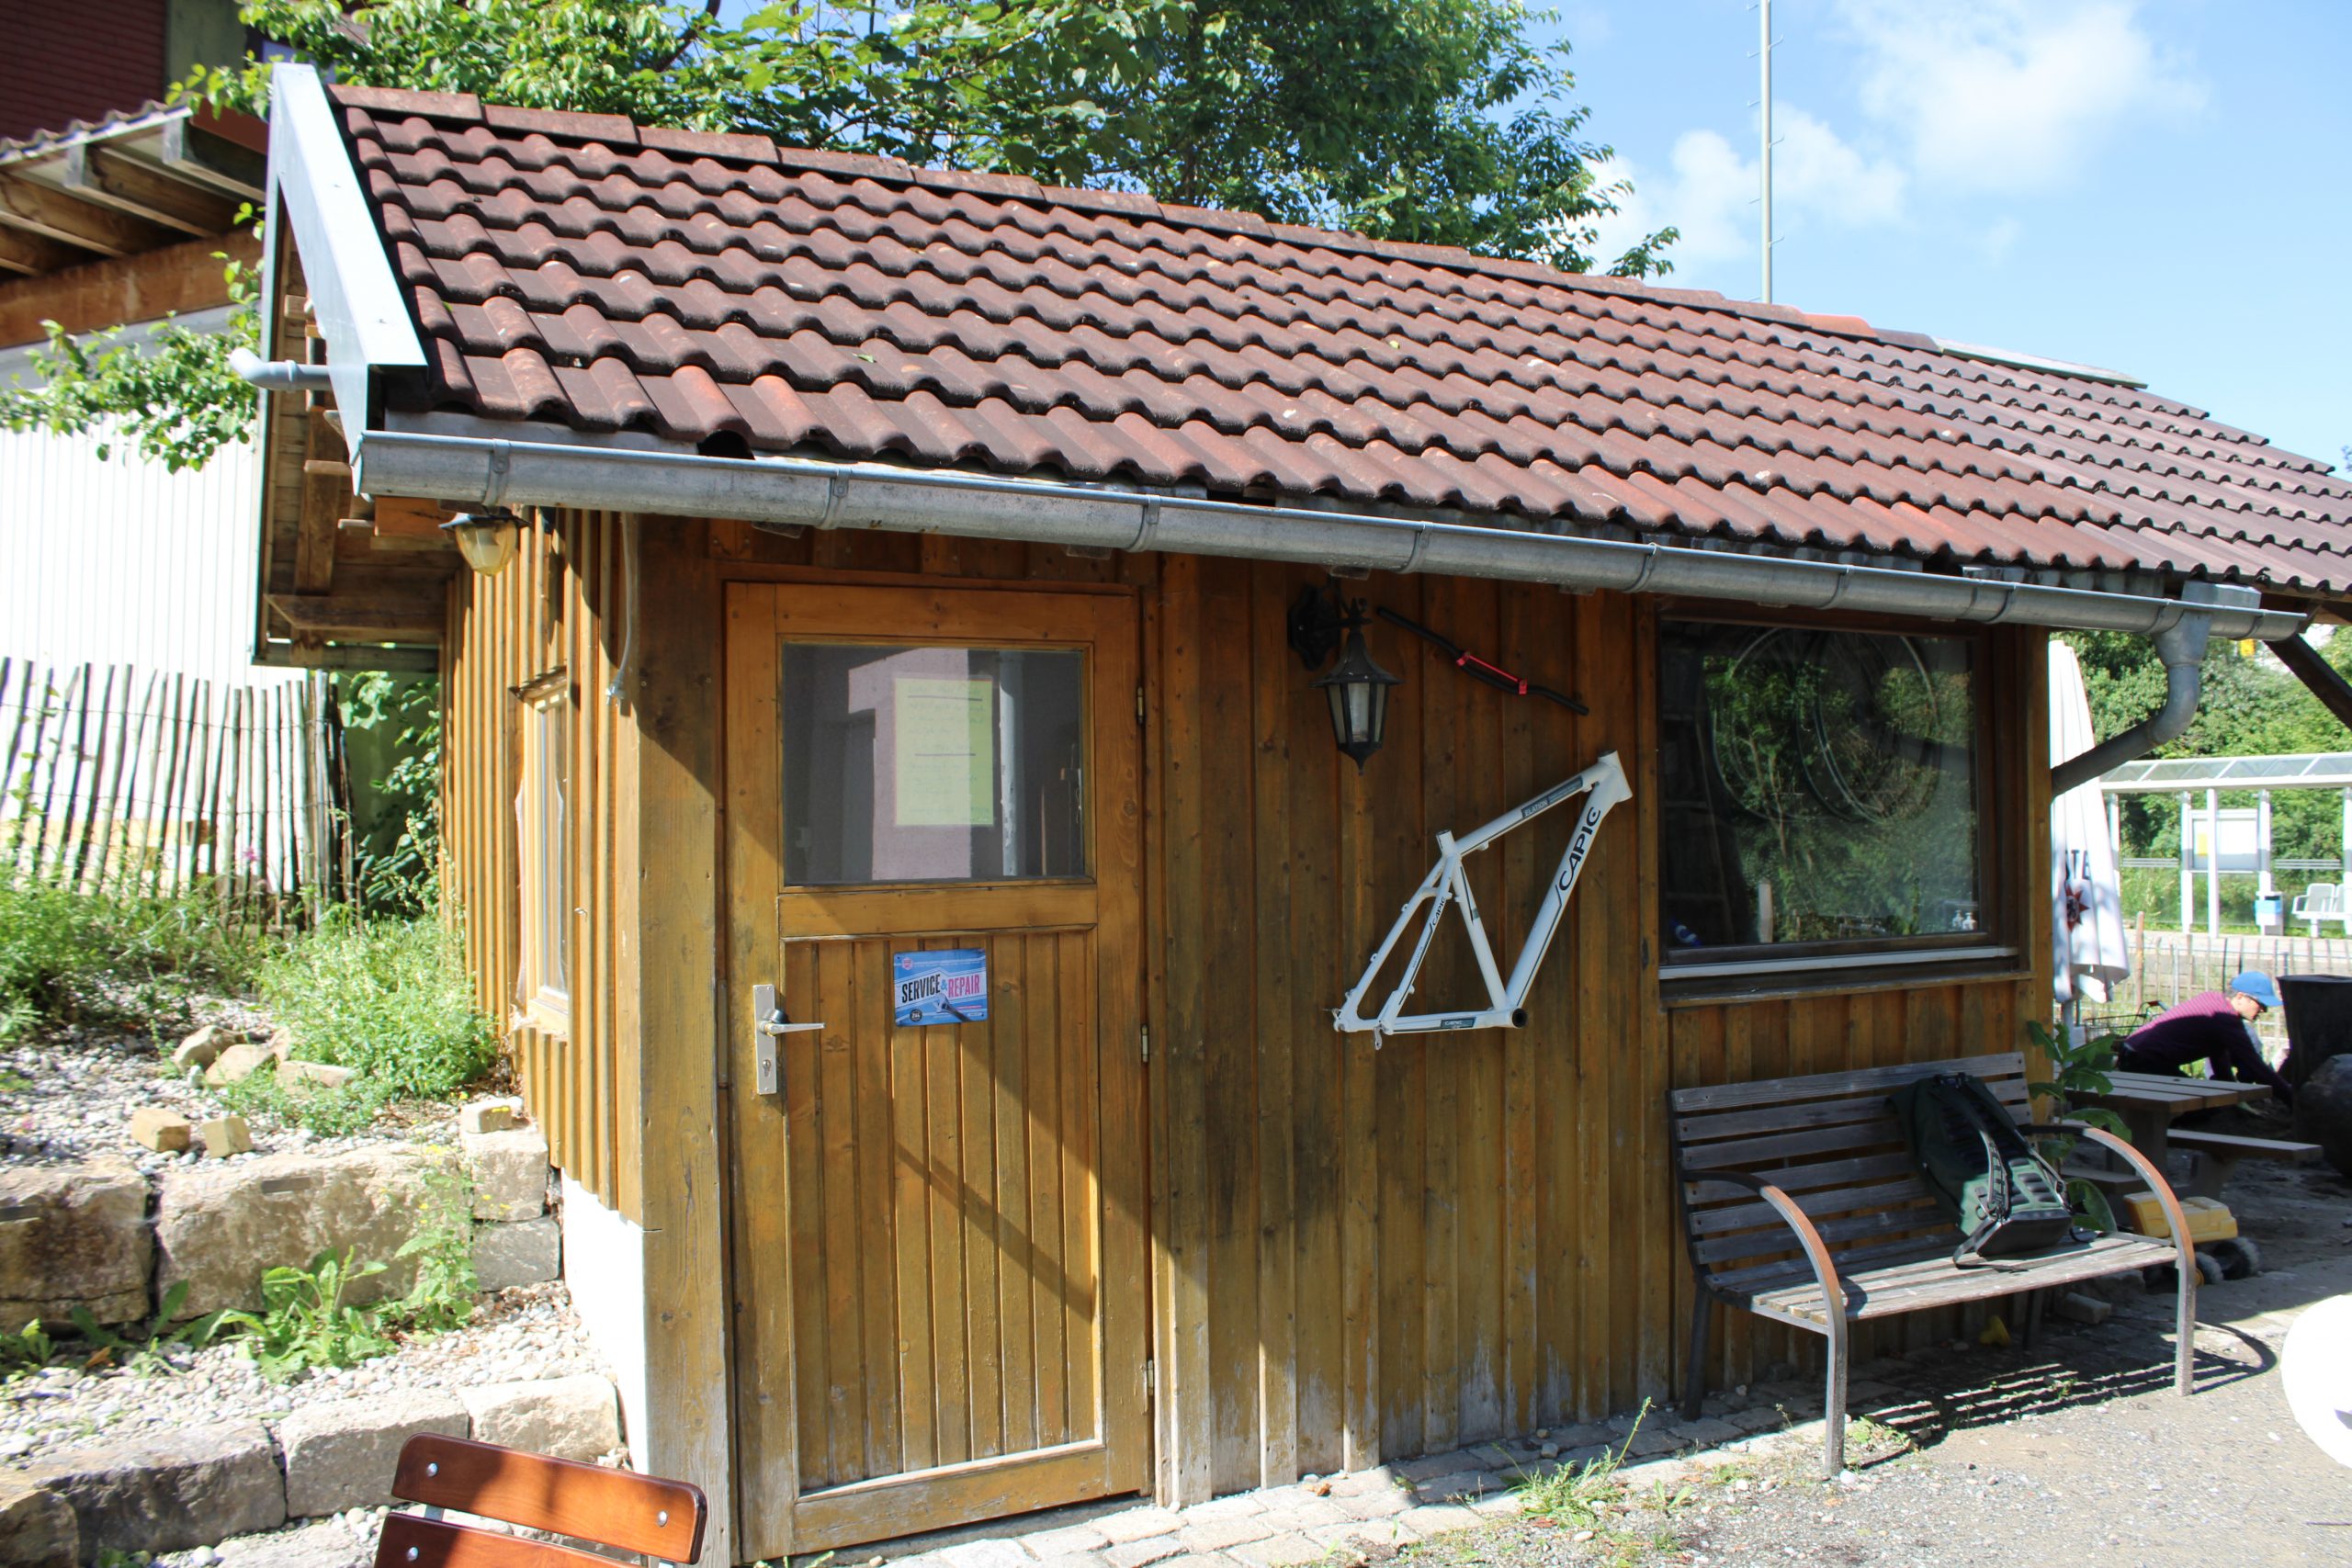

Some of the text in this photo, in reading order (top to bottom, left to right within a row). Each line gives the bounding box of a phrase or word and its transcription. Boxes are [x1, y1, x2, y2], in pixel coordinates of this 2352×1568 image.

[902, 974, 980, 1003] SERVICE & REPAIR
